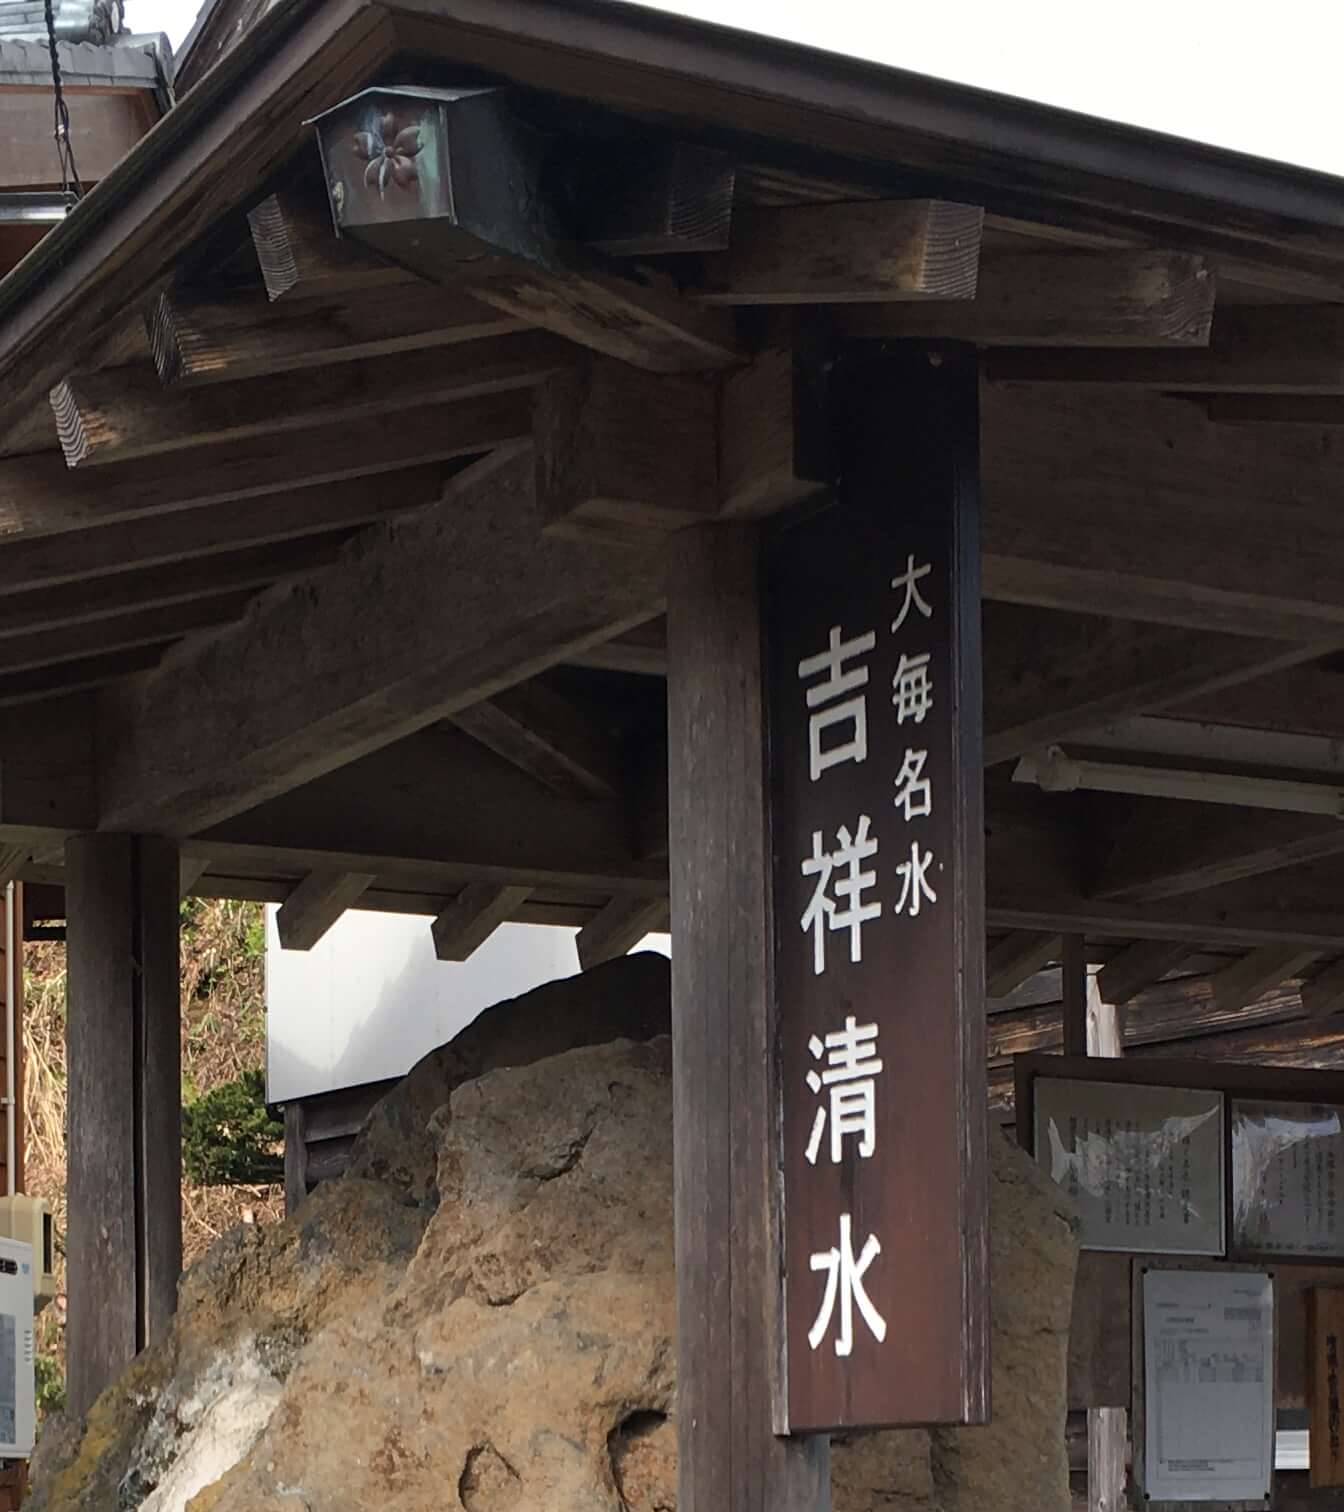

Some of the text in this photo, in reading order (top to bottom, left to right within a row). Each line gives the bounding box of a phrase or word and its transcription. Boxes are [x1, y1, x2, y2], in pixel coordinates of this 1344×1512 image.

[798, 625, 887, 1357] 吉祥清水
[890, 554, 937, 917] 大毎名水
